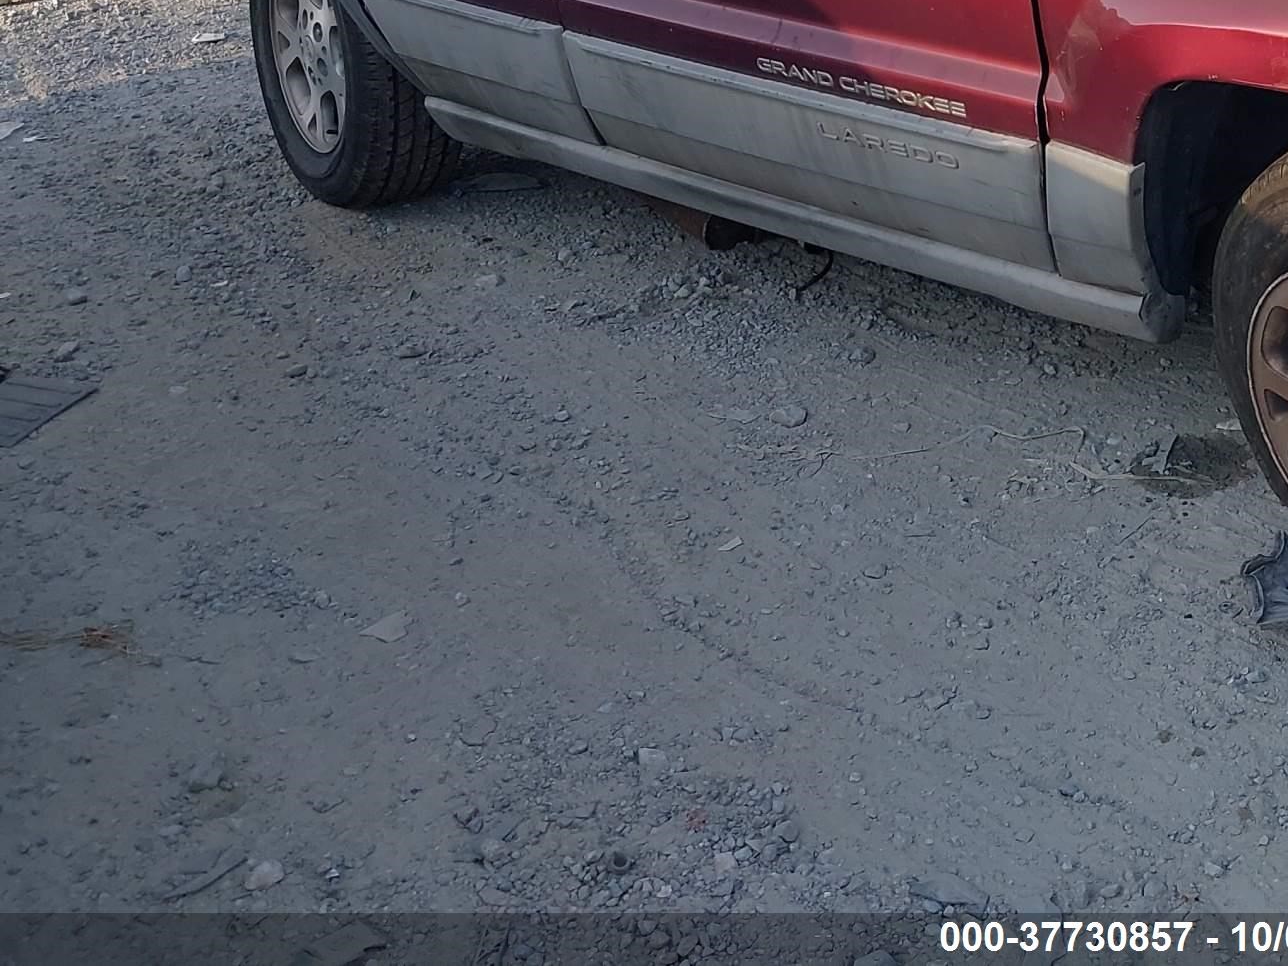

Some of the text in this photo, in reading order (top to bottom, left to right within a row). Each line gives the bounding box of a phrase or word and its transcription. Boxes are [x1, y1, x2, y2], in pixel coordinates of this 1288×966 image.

[756, 56, 967, 118] GRAND CHEROKEE
[816, 121, 960, 170] LAREDO
